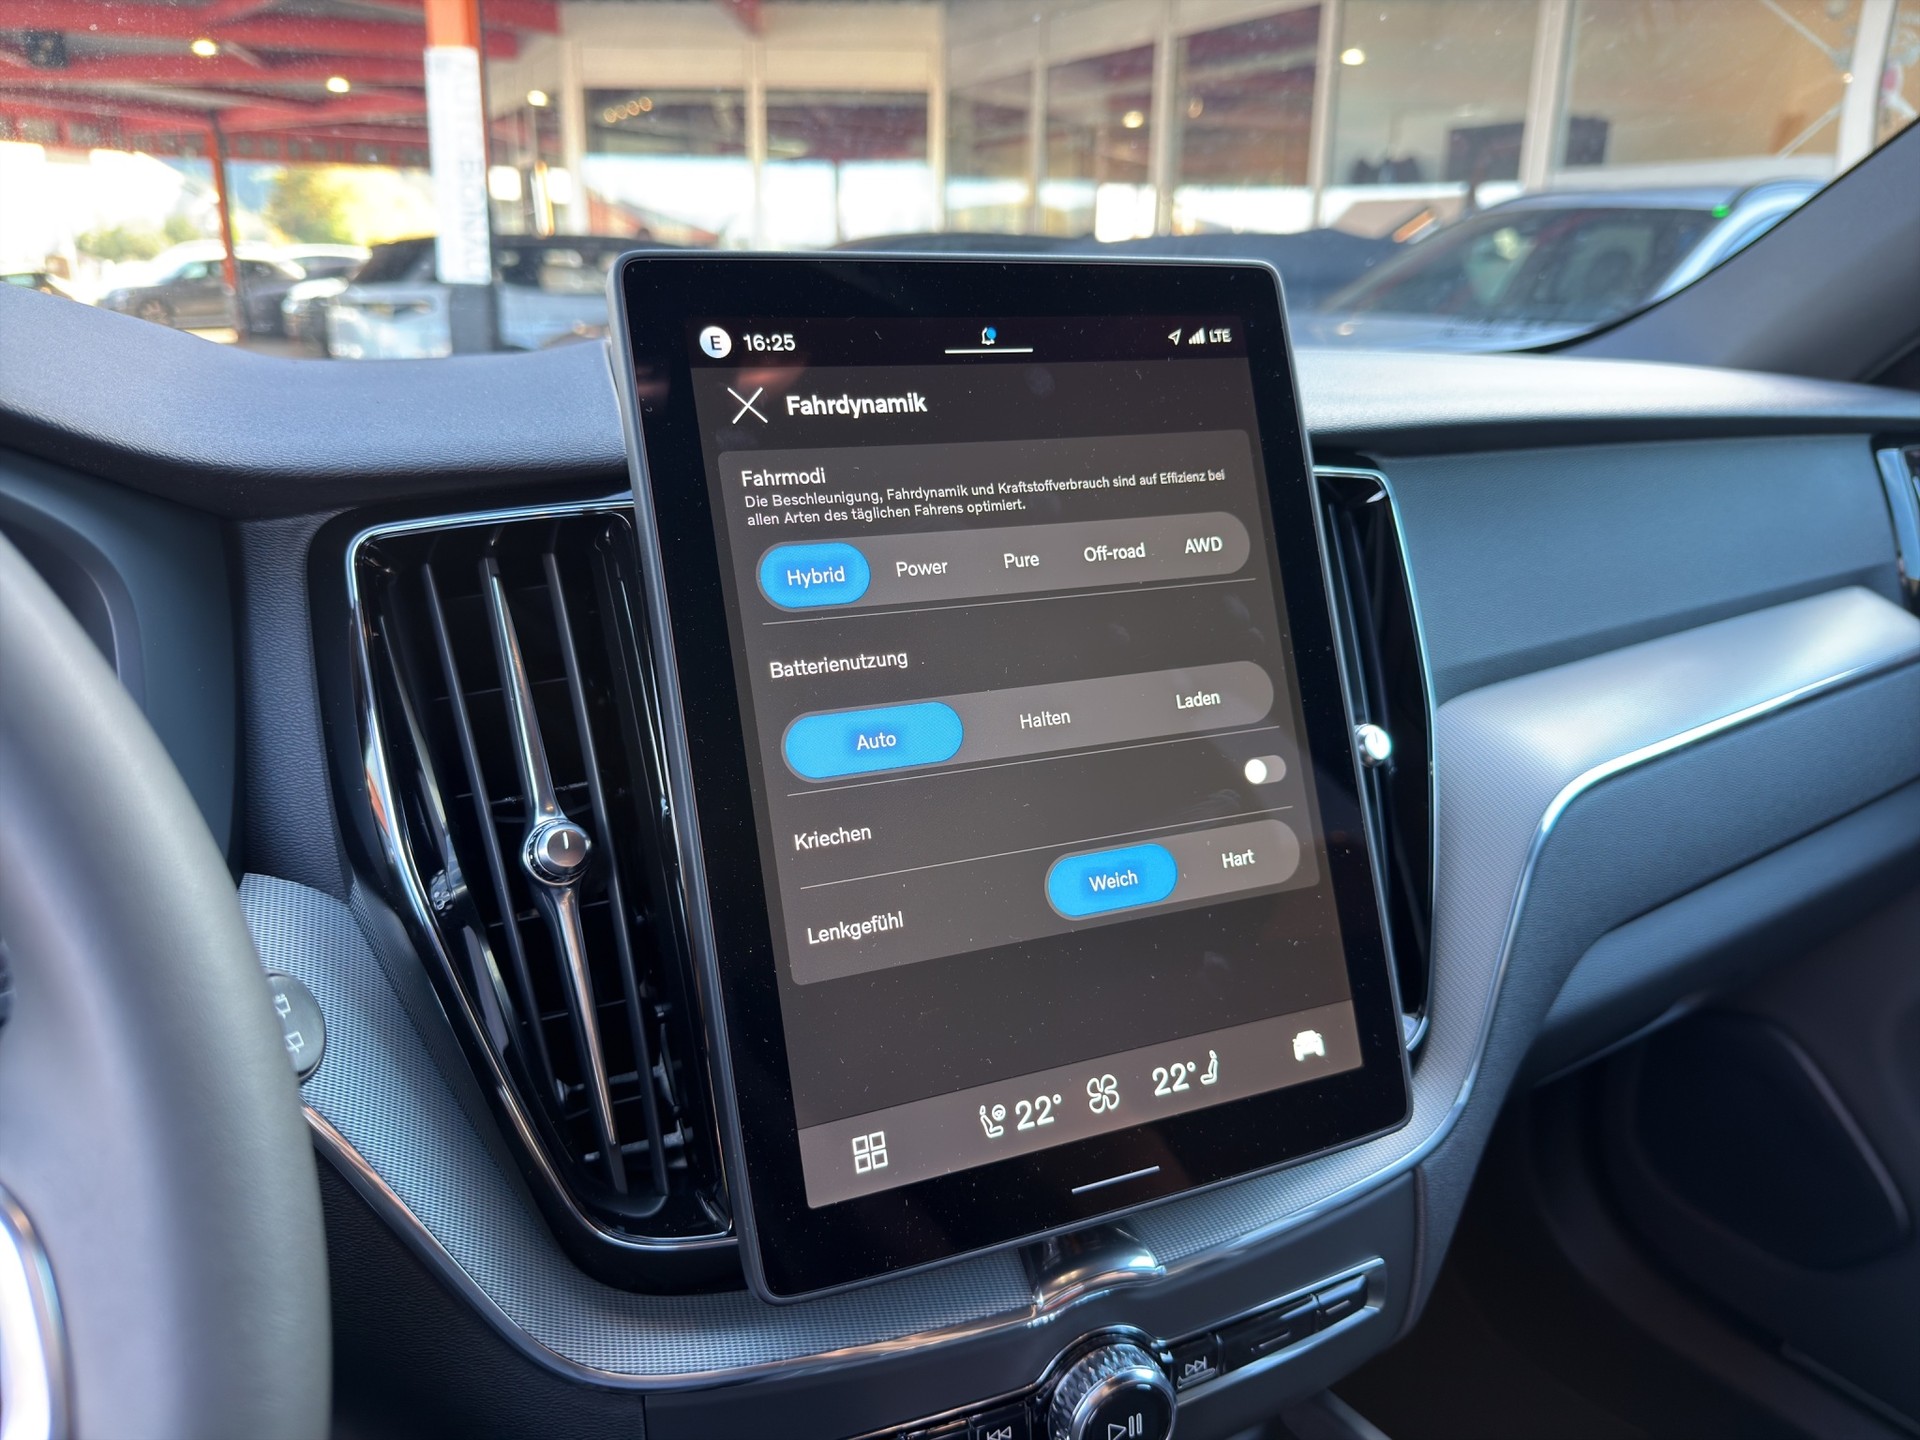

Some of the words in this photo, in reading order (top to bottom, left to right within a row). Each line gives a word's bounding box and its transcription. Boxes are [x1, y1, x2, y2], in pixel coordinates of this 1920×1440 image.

[710, 335, 722, 351] E
[743, 334, 796, 352] 16:25
[1209, 328, 1232, 343] LTE
[786, 392, 928, 419] Fahrdynamik
[741, 467, 826, 488] Fahrmodi
[745, 494, 768, 508] Die
[773, 489, 882, 505] Beschleunigung,
[886, 484, 968, 501] Fahrdynamik
[971, 483, 995, 497] und
[998, 476, 1110, 495] Kraftstoffverbrauch
[1112, 474, 1136, 487] sind
[1139, 472, 1158, 485] auf
[1160, 470, 1206, 484] Effizienz
[1208, 468, 1226, 482] bei
[747, 510, 780, 526] allen
[784, 507, 820, 525] Arten
[824, 507, 848, 522] des
[850, 502, 911, 523] täglichen
[914, 500, 964, 517] Fahrens
[967, 499, 1026, 515] optimiert.
[1083, 541, 1146, 563] Off-road
[1184, 535, 1223, 555] AWD
[896, 560, 948, 578] Power
[1003, 552, 1040, 569] Pure
[787, 565, 845, 588] Hybrid
[769, 653, 907, 678] Batterienutzung
[1176, 690, 1221, 710] Laden
[1019, 709, 1071, 730] Halten
[857, 733, 896, 750] Auto
[794, 827, 871, 851] Kriechen
[1221, 849, 1255, 870] Hart
[1089, 869, 1138, 892] Weich
[807, 911, 904, 944] Lenkgefühl
[1152, 1061, 1196, 1096] 22°
[1015, 1094, 1062, 1131] 22°
